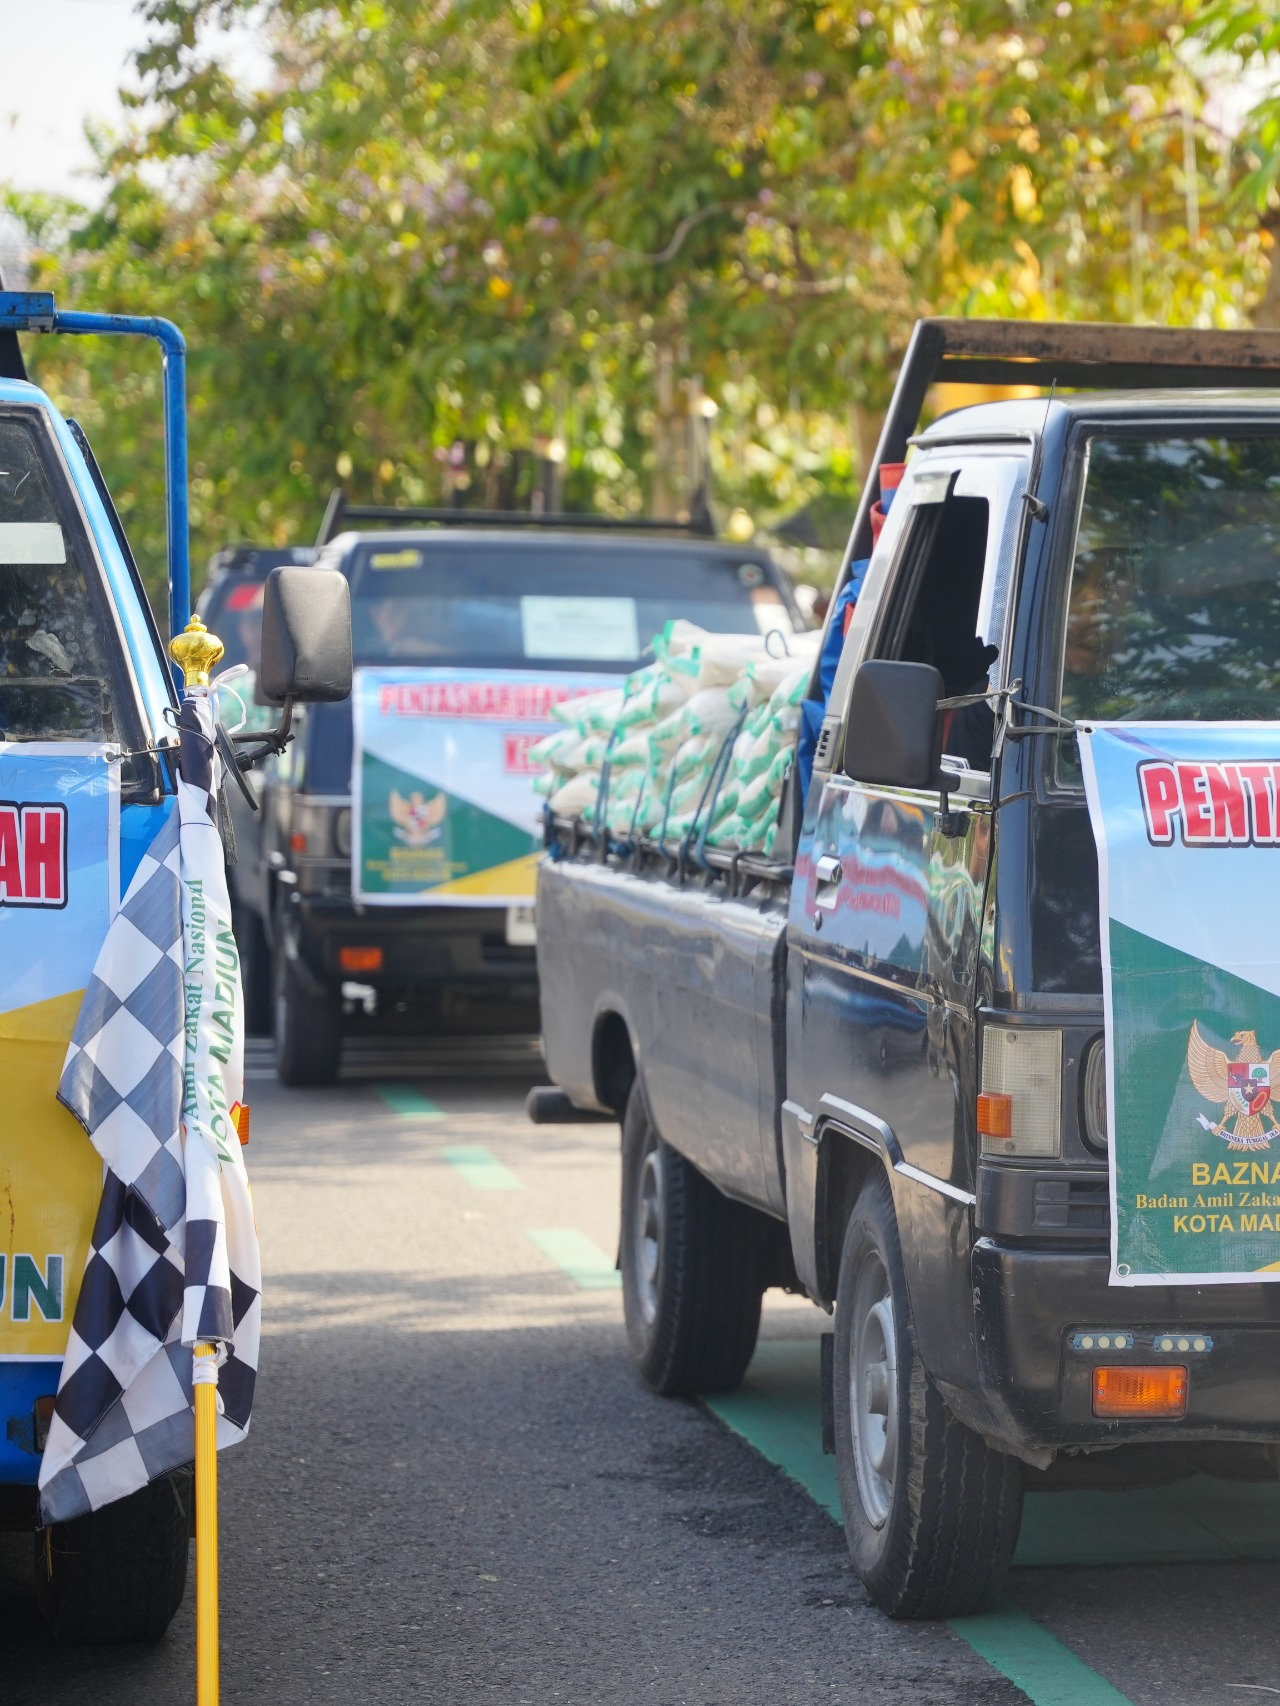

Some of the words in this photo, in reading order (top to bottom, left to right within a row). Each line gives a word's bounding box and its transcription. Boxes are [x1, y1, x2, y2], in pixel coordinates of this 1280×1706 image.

[1135, 1193, 1188, 1209] Badan
[1193, 1192, 1233, 1208] Amil
[1173, 1214, 1235, 1233] KOTA
